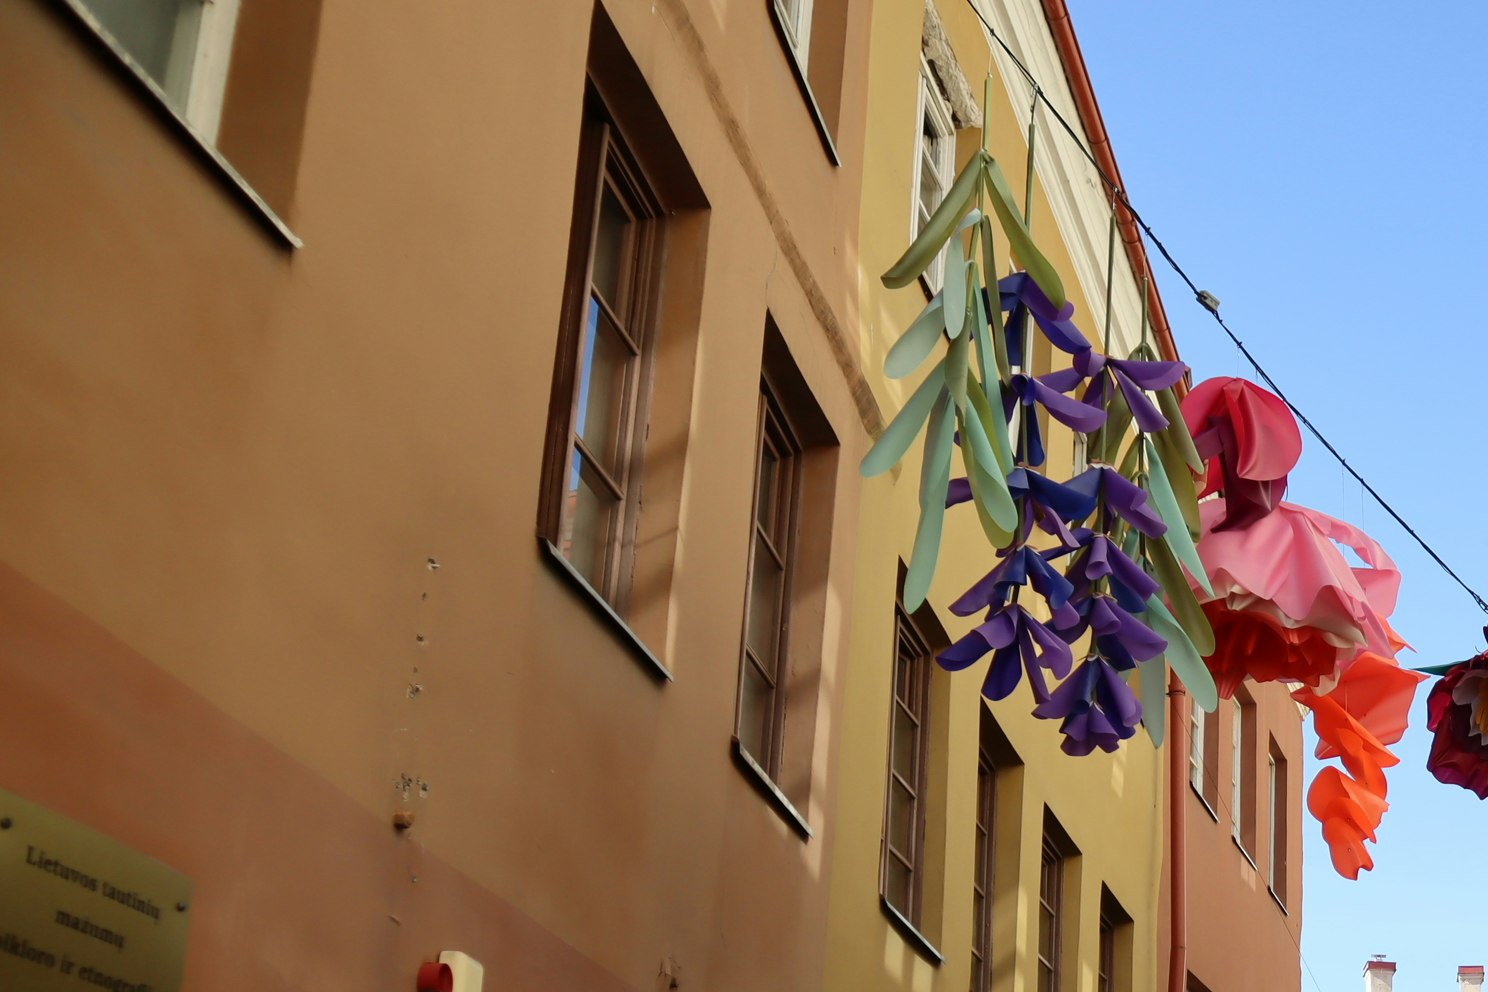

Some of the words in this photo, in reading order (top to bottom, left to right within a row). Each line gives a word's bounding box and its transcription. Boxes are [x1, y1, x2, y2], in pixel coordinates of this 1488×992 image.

[25, 845, 98, 892] Lietuvos
[102, 881, 161, 925] tautinių
[60, 954, 76, 976] ir
